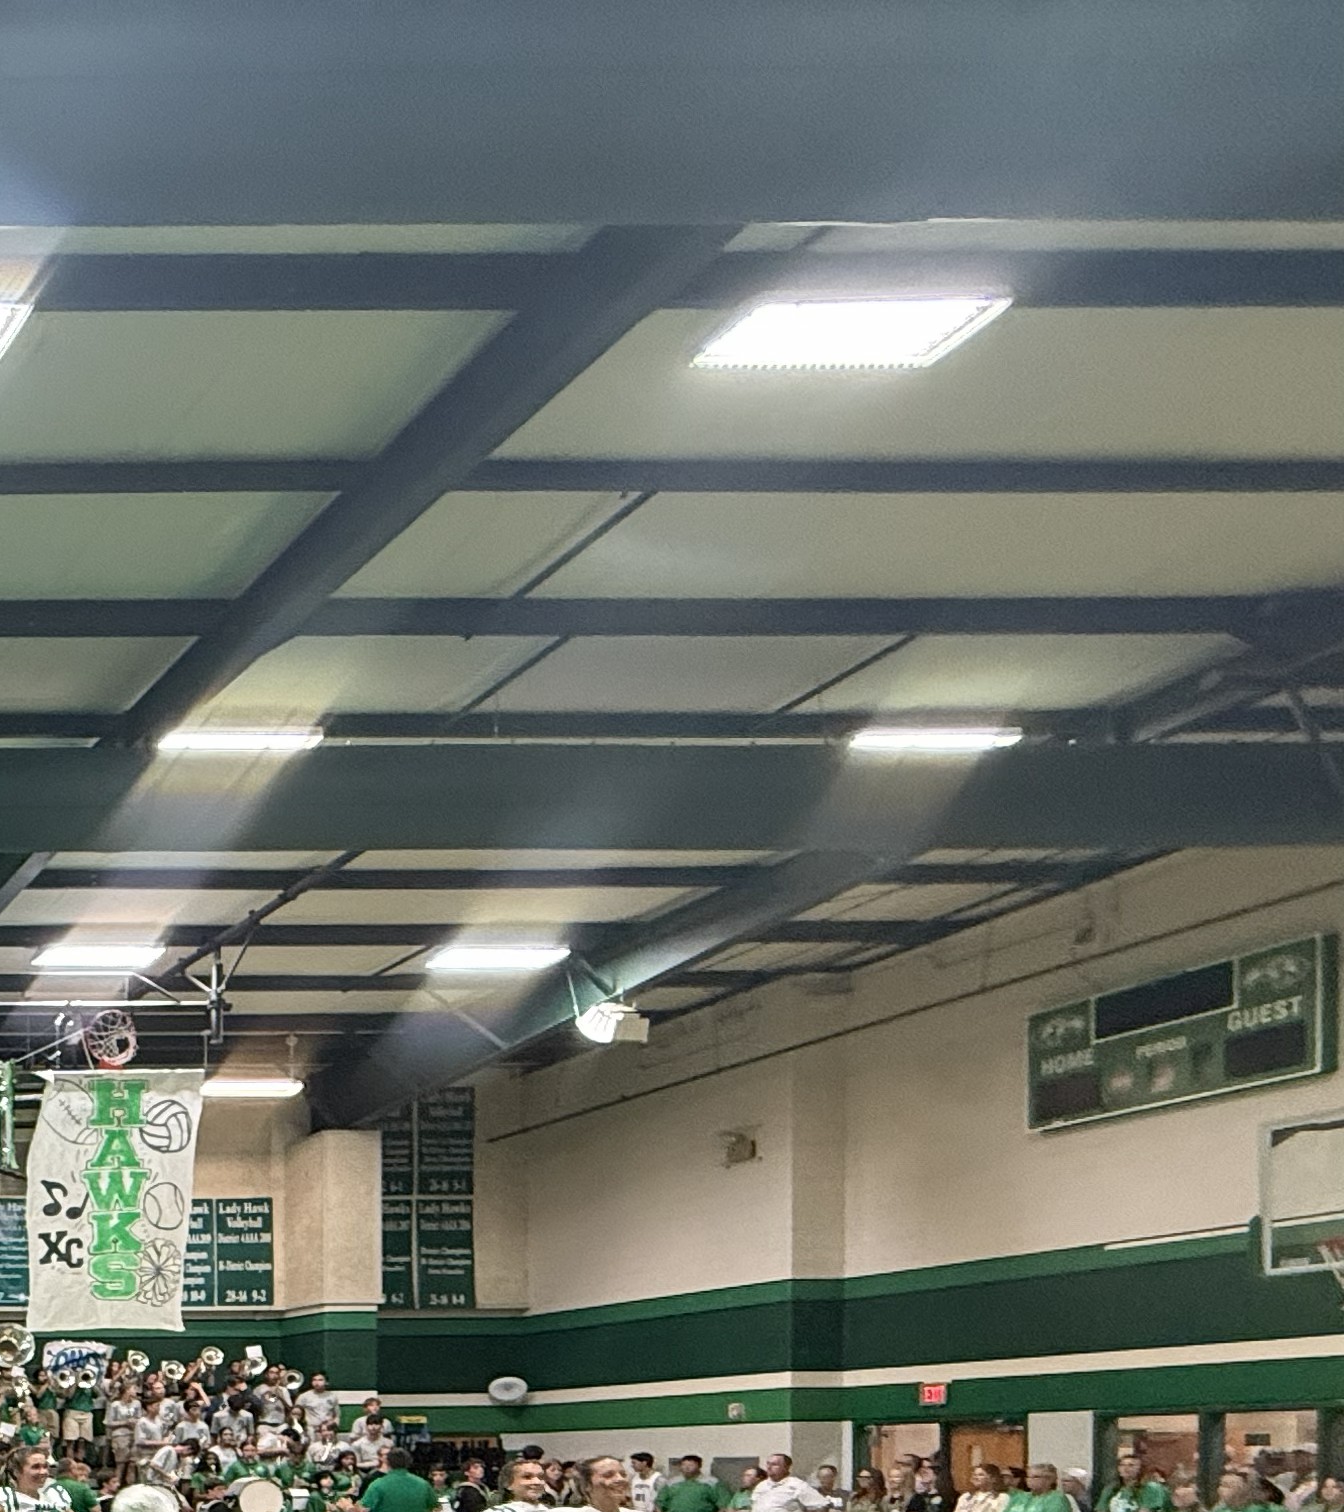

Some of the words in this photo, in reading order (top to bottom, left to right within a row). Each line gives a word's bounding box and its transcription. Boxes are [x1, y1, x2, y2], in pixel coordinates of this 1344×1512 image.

[1227, 996, 1303, 1032] GUEST
[1040, 1048, 1095, 1075] HOME
[82, 1079, 151, 1300] HAWKS
[218, 1202, 241, 1218] Lady
[243, 1202, 270, 1214] Hawk
[38, 1230, 84, 1269] XC
